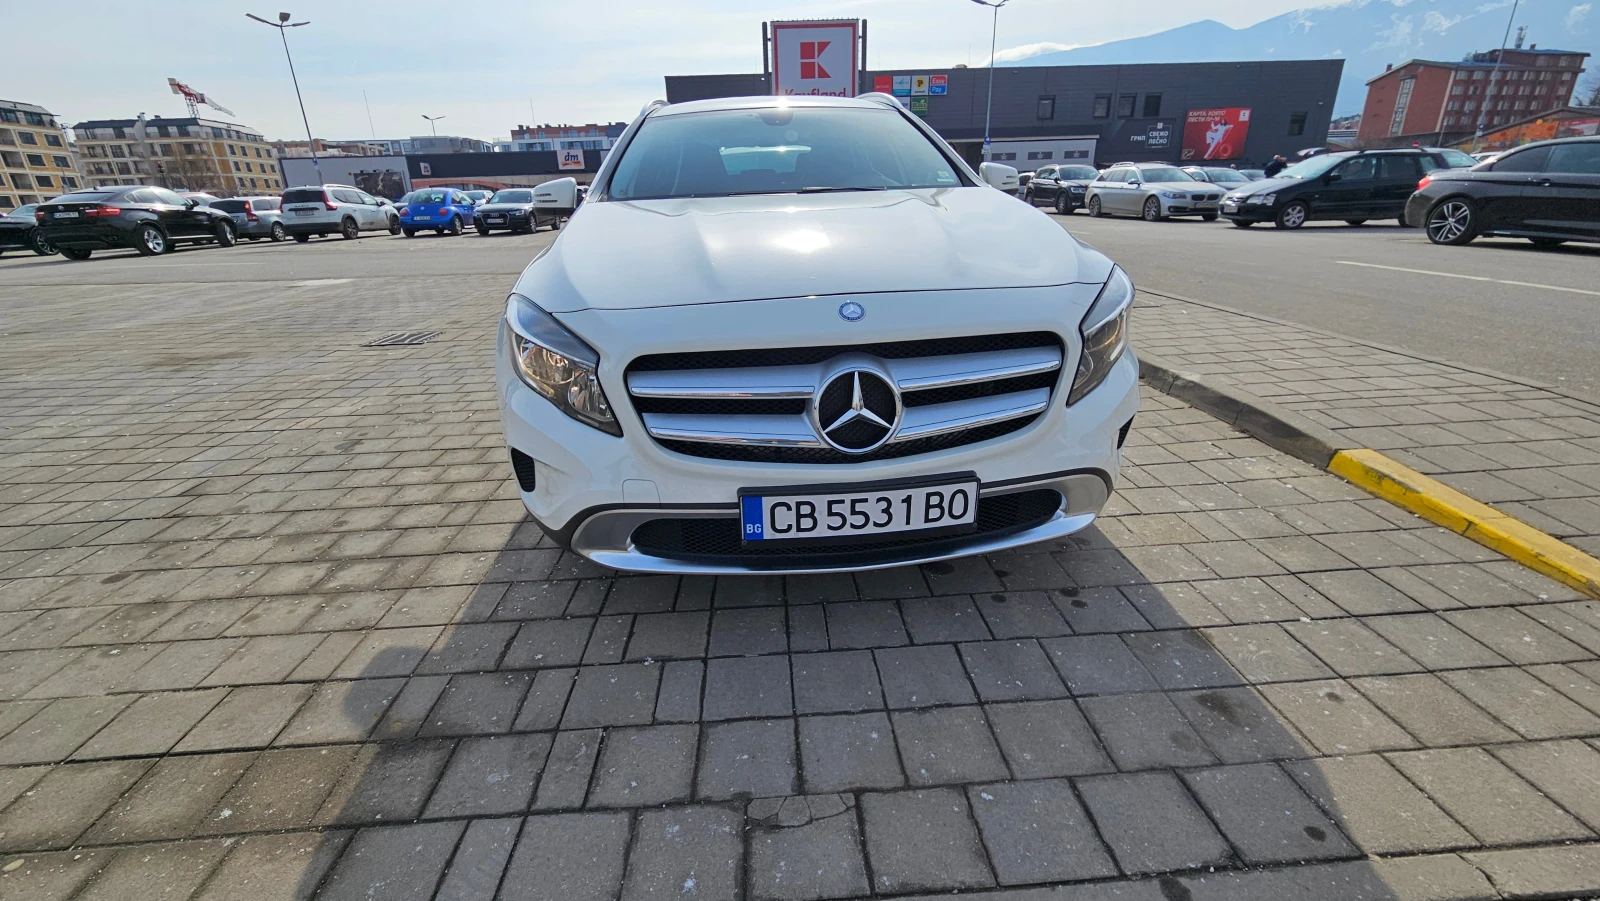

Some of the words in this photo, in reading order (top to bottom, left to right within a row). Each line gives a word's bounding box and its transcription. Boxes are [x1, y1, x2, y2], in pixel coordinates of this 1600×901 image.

[932, 77, 946, 85] Easy
[564, 152, 579, 162] dm
[746, 523, 762, 534] BG
